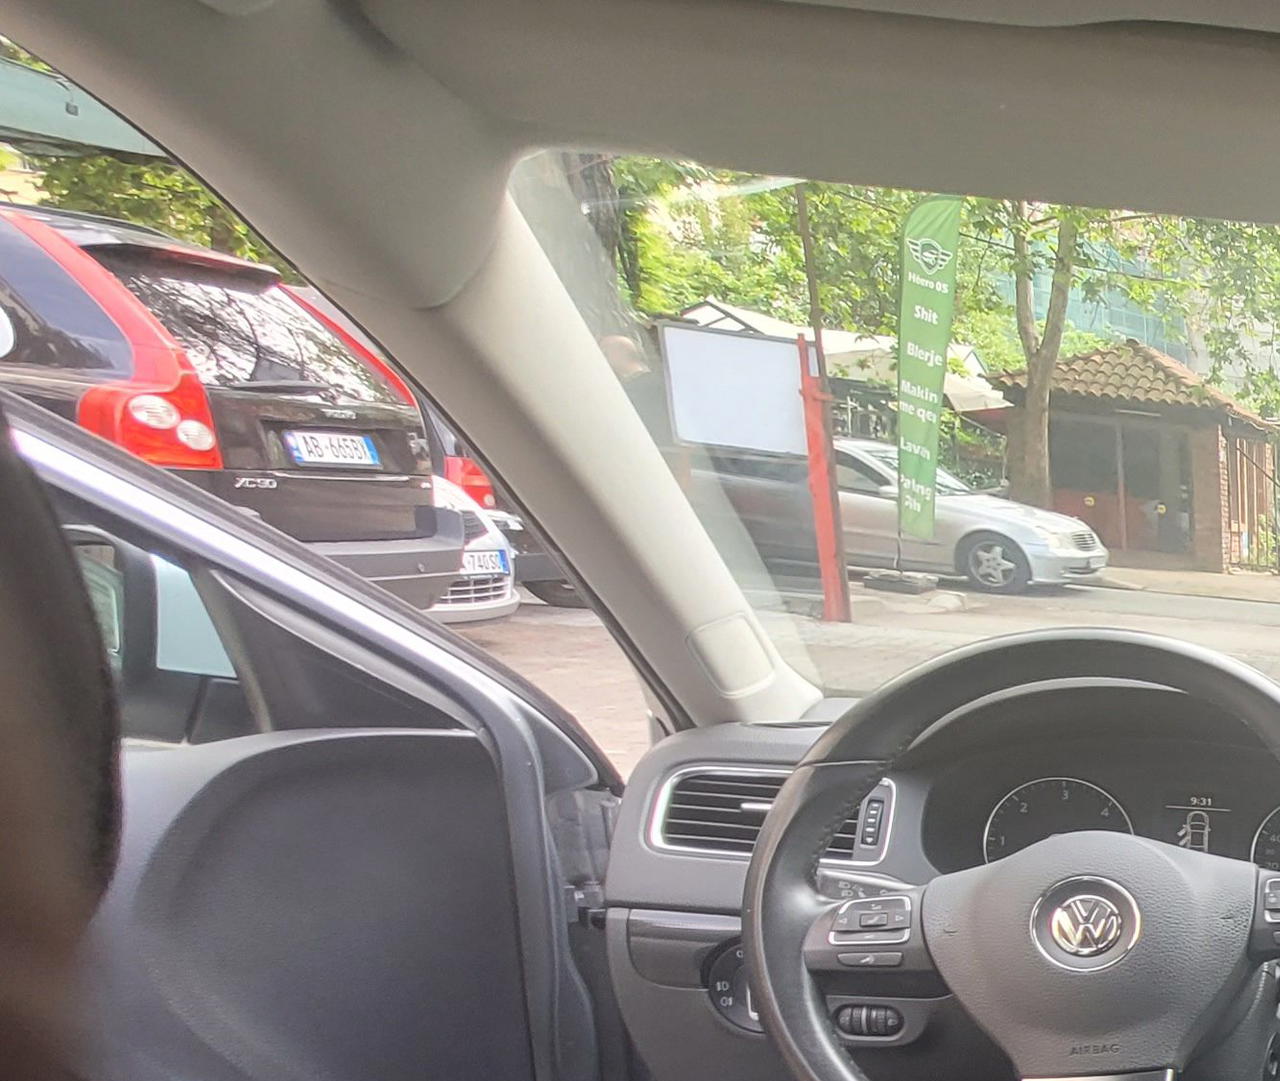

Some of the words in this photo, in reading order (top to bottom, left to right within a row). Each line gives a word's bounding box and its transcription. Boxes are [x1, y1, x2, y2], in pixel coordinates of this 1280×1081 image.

[914, 305, 938, 325] Shit
[906, 342, 943, 367] Blerje
[234, 477, 277, 489] XC90
[1062, 790, 1069, 800] 3
[1190, 796, 1212, 807] 9:31
[1020, 802, 1028, 813] 2
[1100, 807, 1109, 817] 4
[1069, 1043, 1120, 1057] AIRBAG
